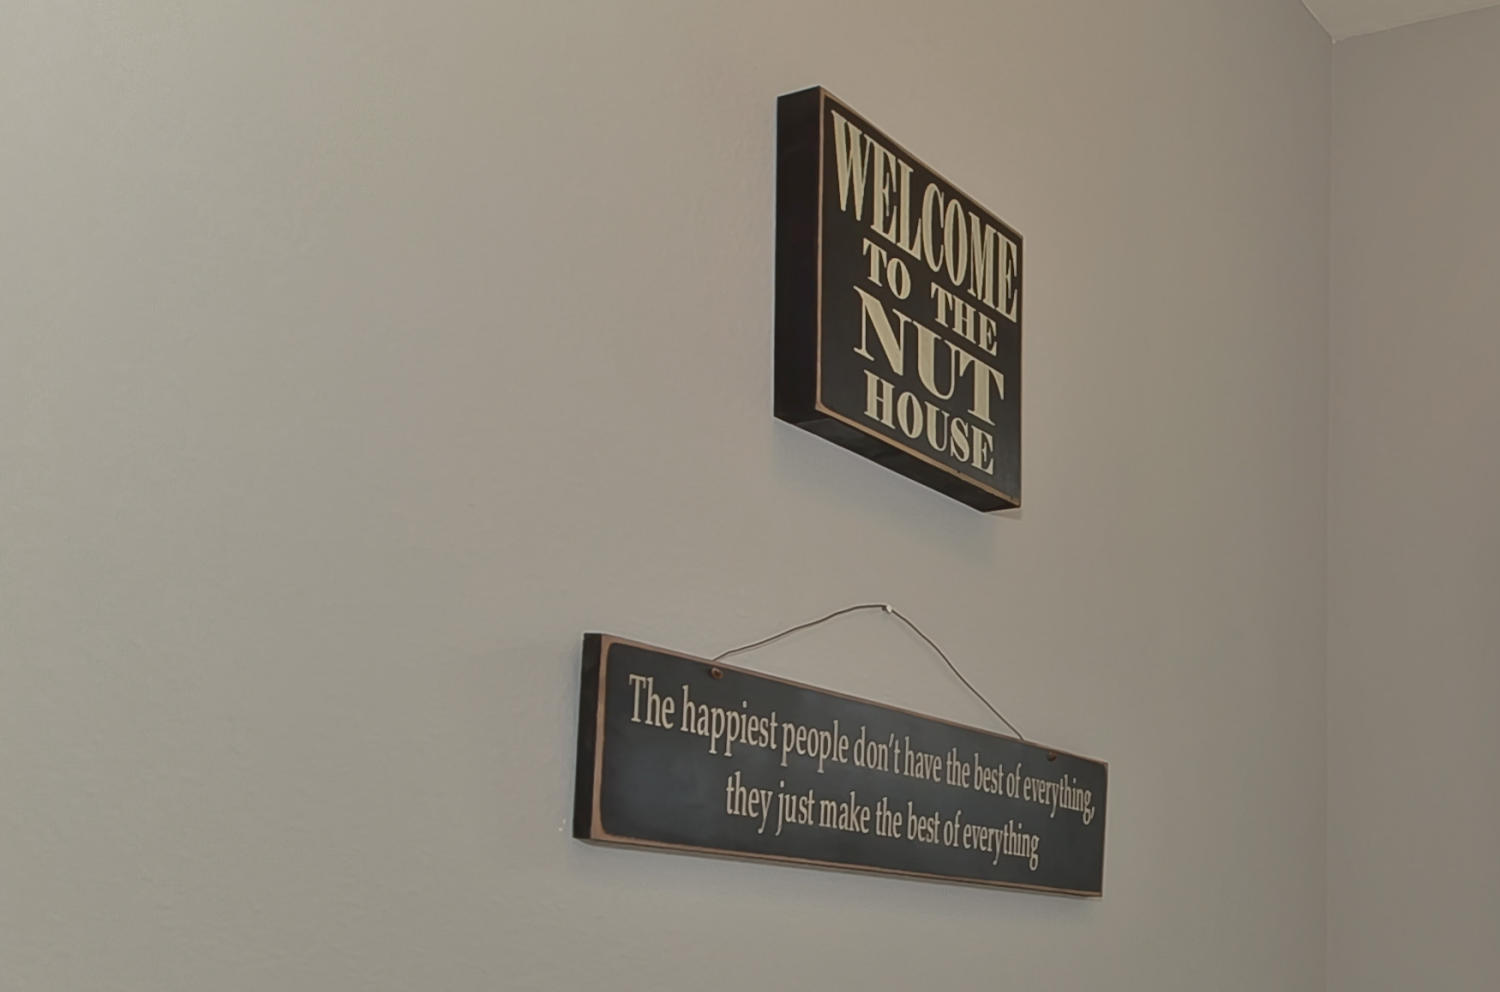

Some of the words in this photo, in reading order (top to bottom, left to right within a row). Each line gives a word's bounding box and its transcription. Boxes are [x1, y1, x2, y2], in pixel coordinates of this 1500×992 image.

[831, 109, 1018, 323] WELCOME
[853, 285, 1004, 427] NUT
[862, 237, 911, 300] TO
[930, 281, 998, 357] THE
[863, 368, 995, 475] HOUSE
[628, 673, 675, 730] The
[681, 684, 777, 758] happiest
[781, 718, 849, 773] people
[854, 725, 901, 774] don't
[904, 736, 942, 784] have
[945, 747, 971, 789] the
[973, 752, 1004, 797] best
[1006, 761, 1022, 799] of
[1022, 765, 1095, 825] everything,
[725, 770, 772, 836] they
[775, 780, 814, 836] just
[819, 790, 870, 834] make
[875, 796, 902, 838] the
[907, 801, 940, 845] best
[943, 809, 961, 848] of
[962, 816, 1040, 871] everything
